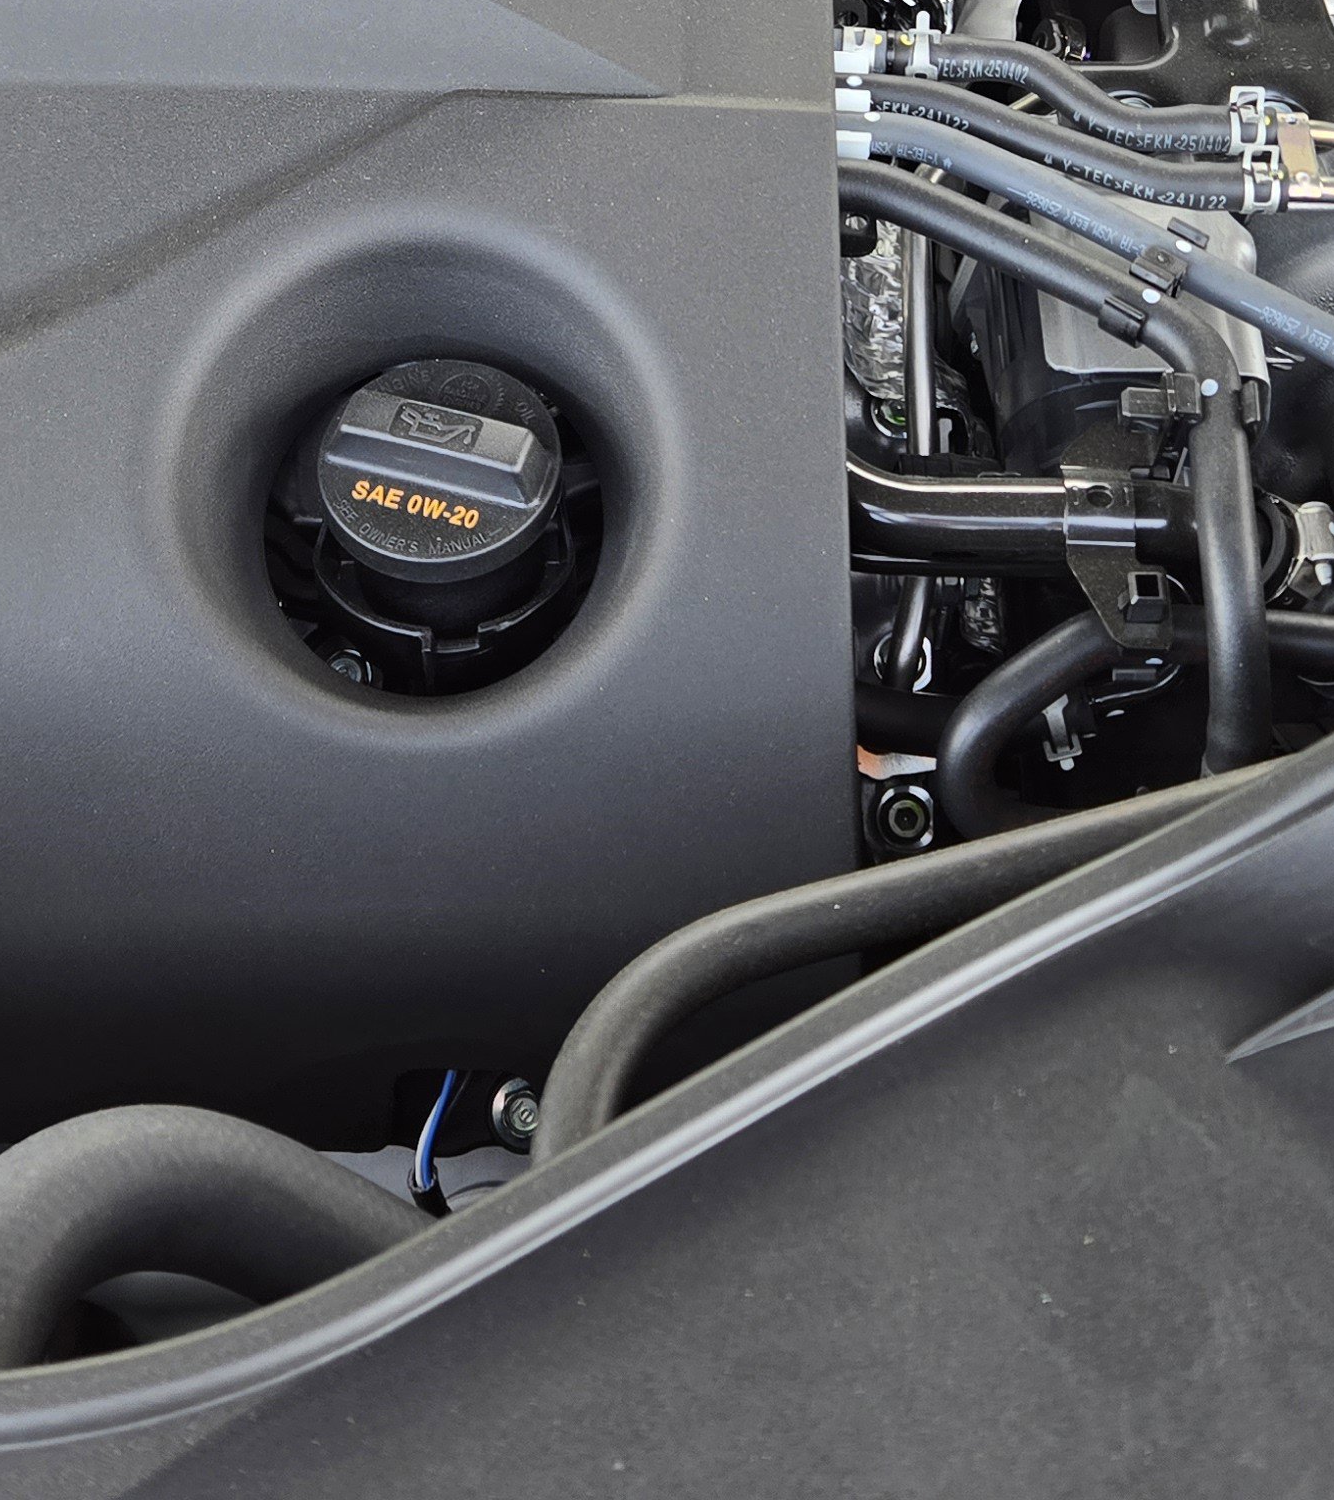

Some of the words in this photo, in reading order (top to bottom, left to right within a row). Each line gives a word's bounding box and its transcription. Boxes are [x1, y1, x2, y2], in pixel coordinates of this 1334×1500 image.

[333, 499, 357, 522] SEE
[358, 521, 420, 554] OWNER'S
[427, 531, 489, 555] MANUAL
[351, 479, 404, 510] SAE
[406, 494, 480, 529] 0W-20
